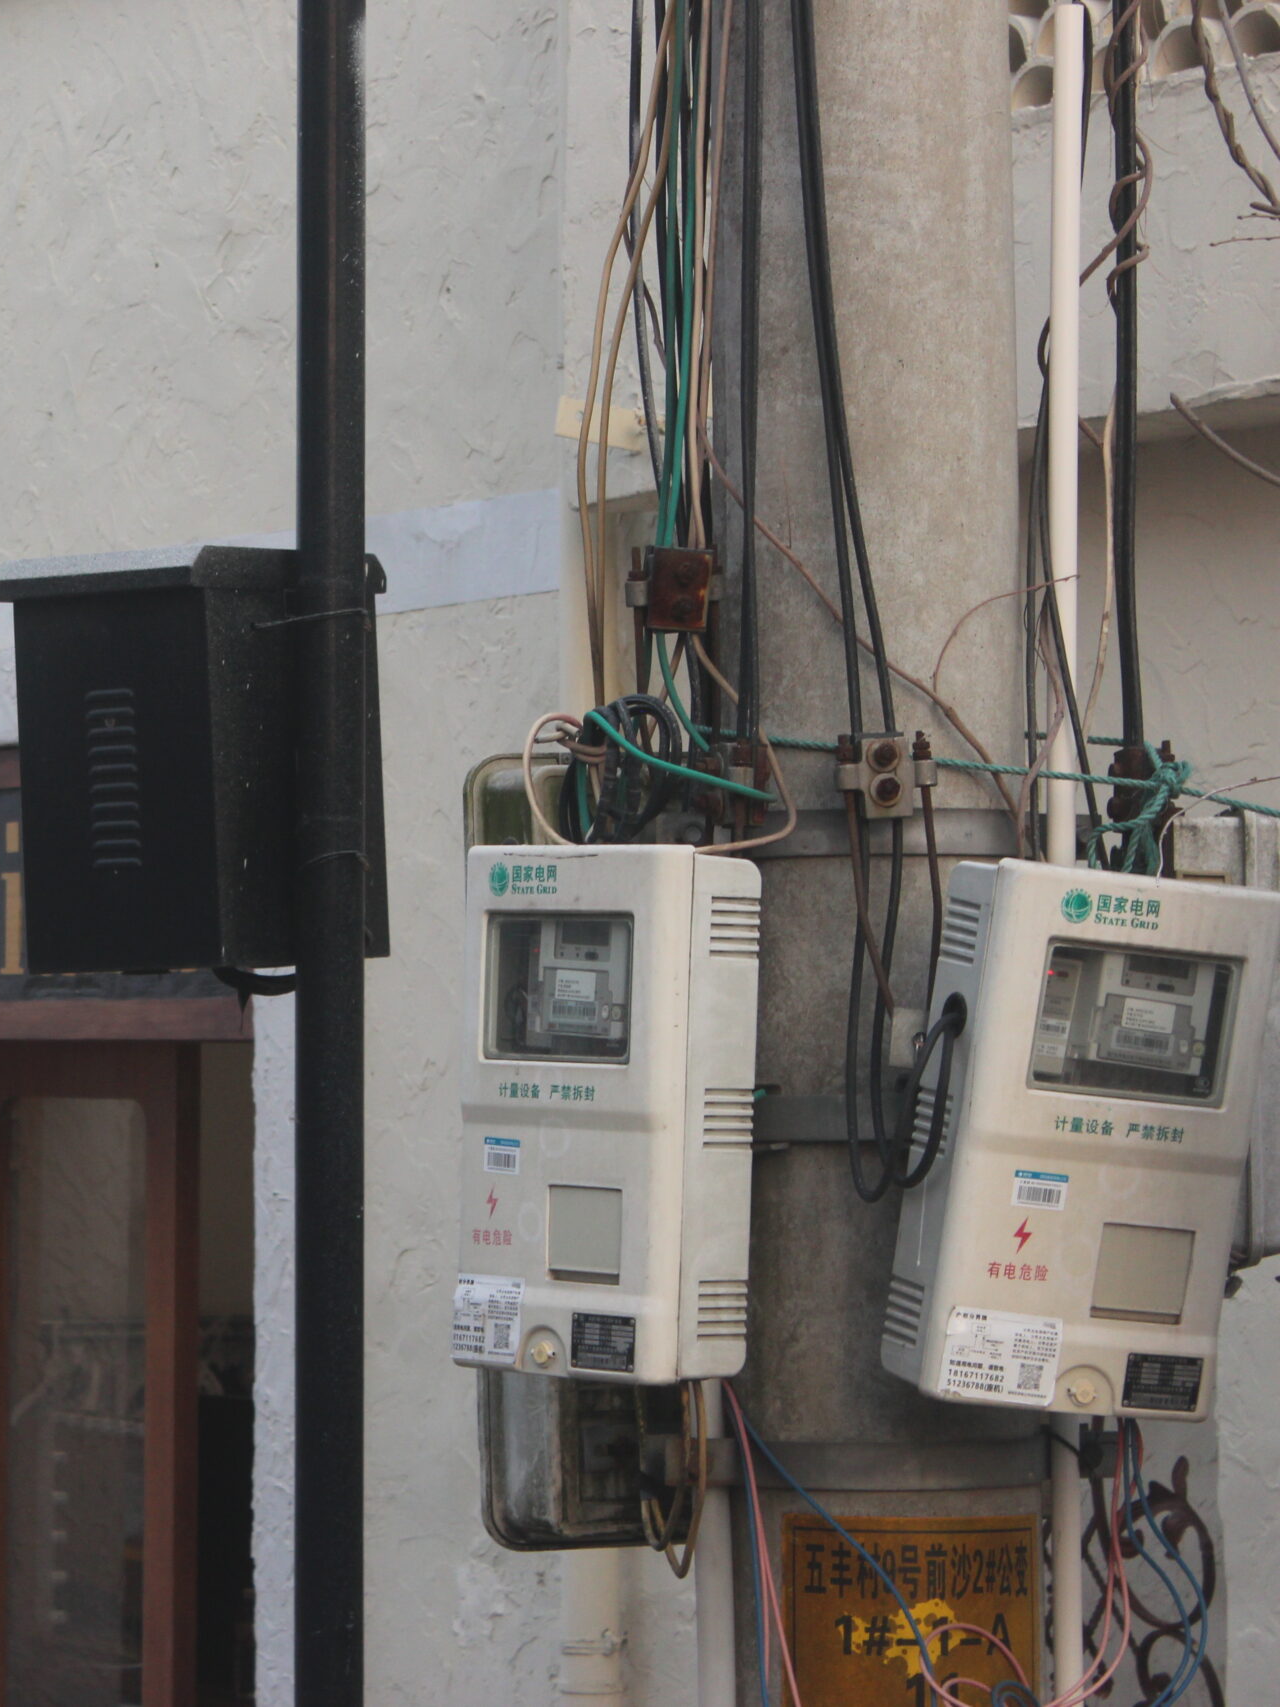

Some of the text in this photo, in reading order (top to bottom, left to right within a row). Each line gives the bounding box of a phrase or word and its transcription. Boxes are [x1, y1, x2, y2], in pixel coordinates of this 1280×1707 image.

[512, 865, 557, 883] 国家电网
[536, 884, 557, 895] GRID
[1097, 894, 1160, 917] 国家电网
[1094, 914, 1159, 931] STATE GRID
[498, 1083, 595, 1101] 计量设备 严禁拆封
[1055, 1116, 1184, 1144] 计量设备 严禁拆封
[472, 1229, 512, 1246] 有电危险
[987, 1261, 1048, 1282] 有电危险
